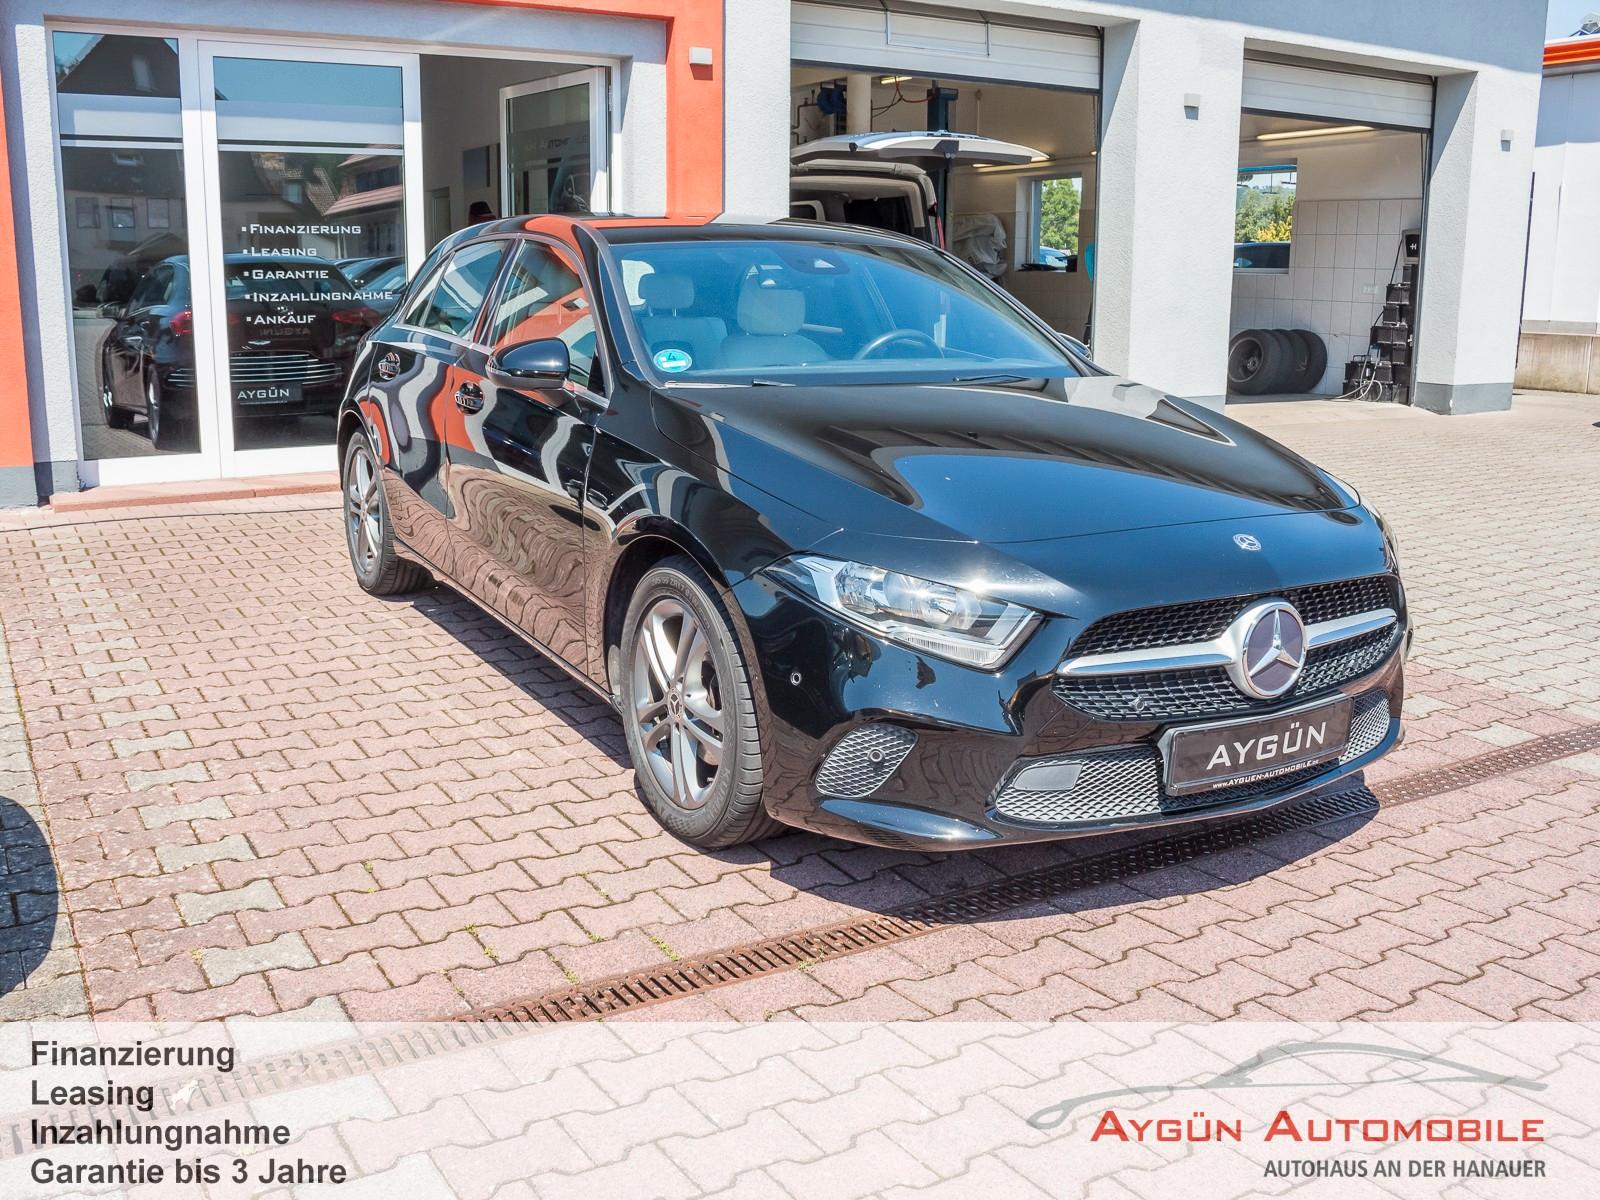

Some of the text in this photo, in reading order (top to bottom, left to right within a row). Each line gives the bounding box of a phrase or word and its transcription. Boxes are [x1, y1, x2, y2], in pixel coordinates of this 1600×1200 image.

[250, 223, 361, 234] FINANZIERUNG
[251, 246, 317, 257] LEASING
[252, 269, 329, 279] GARANTIE
[253, 291, 393, 303] INZAHLUNGNAHME
[237, 386, 289, 399] AYGÜN
[1206, 721, 1327, 770] AYGÜN
